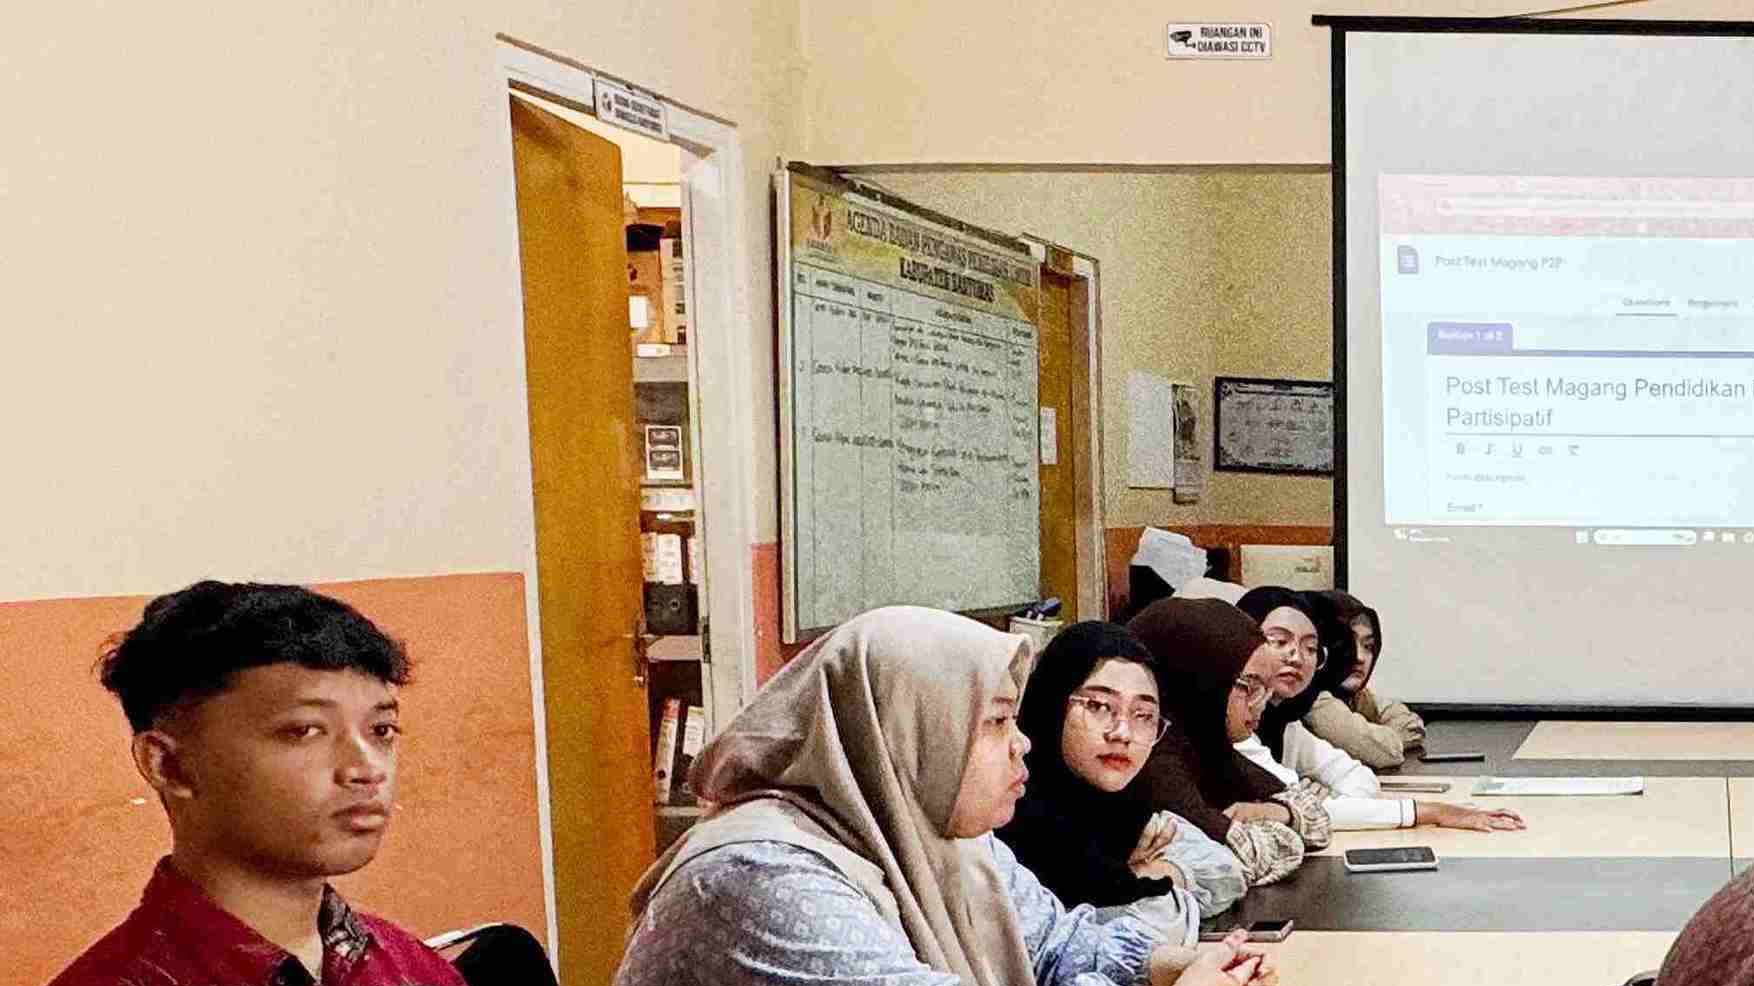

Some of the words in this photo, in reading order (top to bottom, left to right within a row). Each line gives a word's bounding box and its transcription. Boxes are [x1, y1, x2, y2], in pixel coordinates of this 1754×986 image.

[1198, 41, 1238, 53] DIAWASI
[1241, 41, 1266, 53] CCTV
[1446, 376, 1491, 396] Post
[1497, 376, 1539, 396] Test
[1546, 377, 1627, 401] Magang
[1635, 378, 1746, 398] Pendidikan
[1446, 407, 1553, 432] Partisipatif
